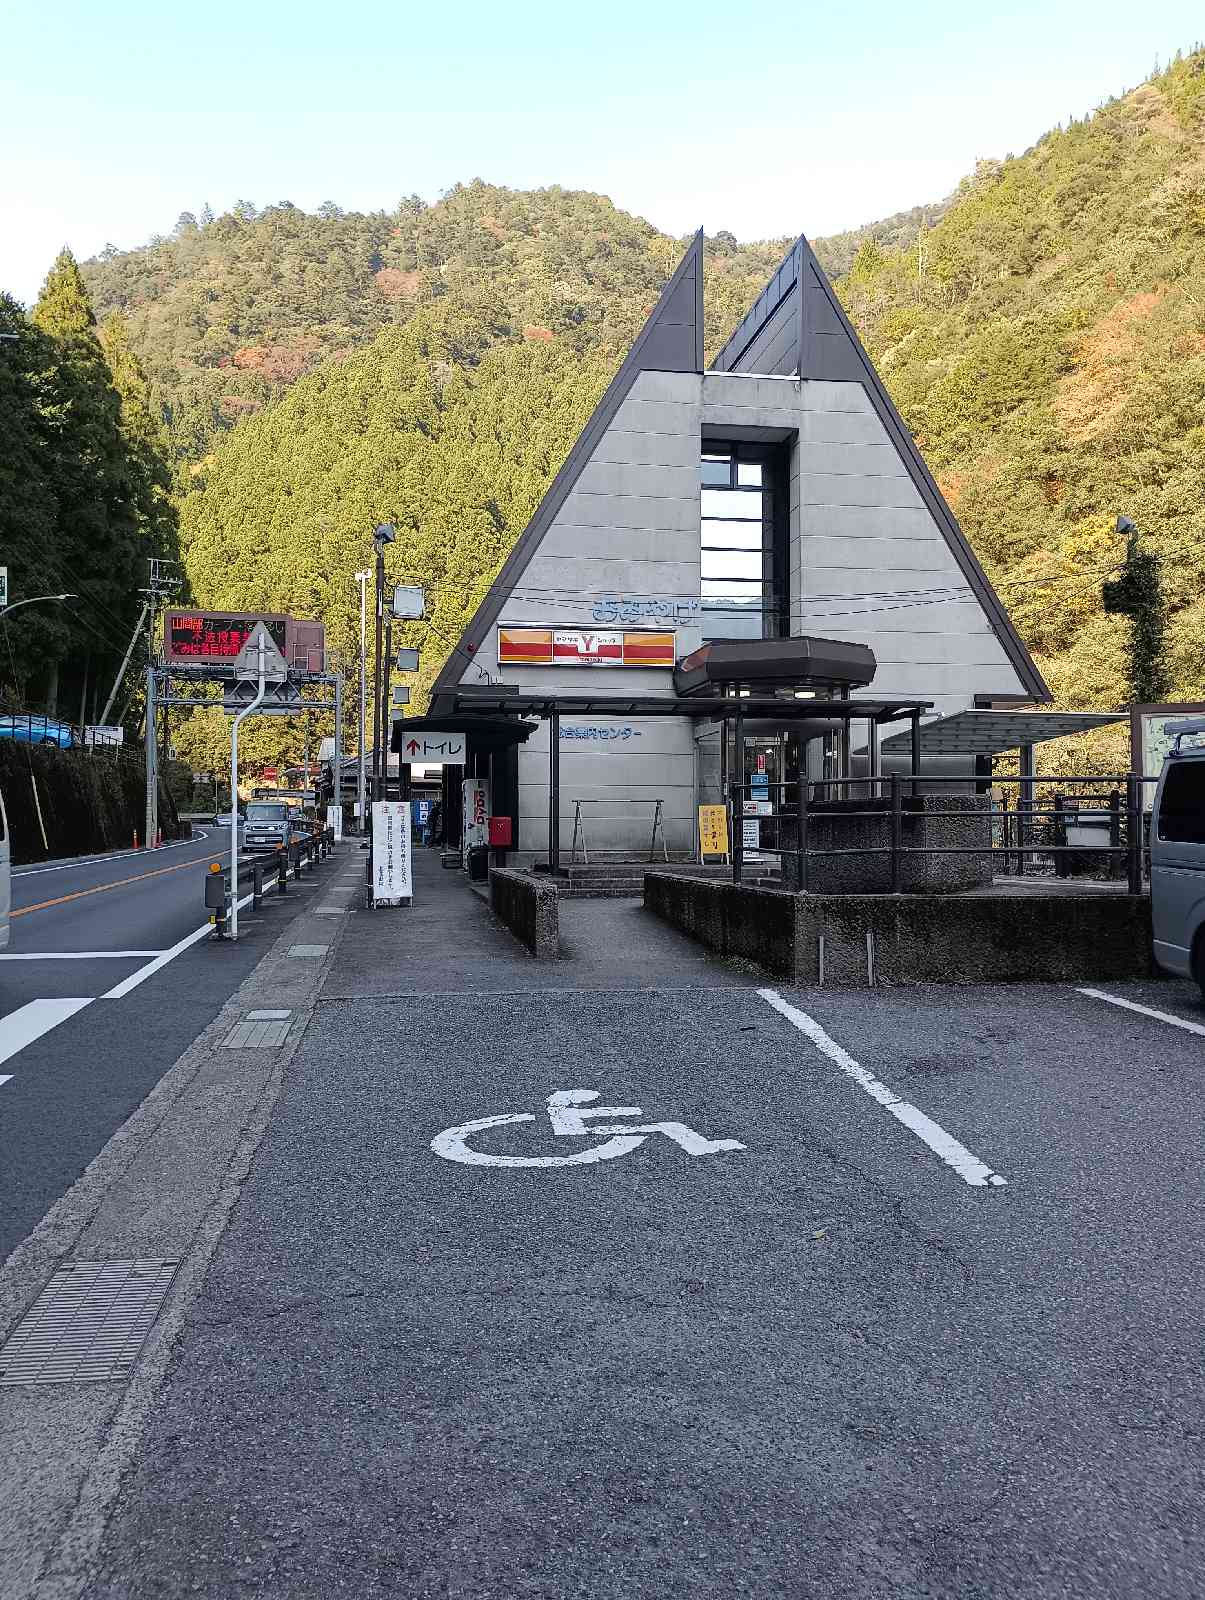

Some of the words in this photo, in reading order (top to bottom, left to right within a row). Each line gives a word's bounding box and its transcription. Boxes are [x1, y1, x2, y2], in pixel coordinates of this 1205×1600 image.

[423, 740, 463, 756] トイレ
[475, 790, 487, 824] DyDo
